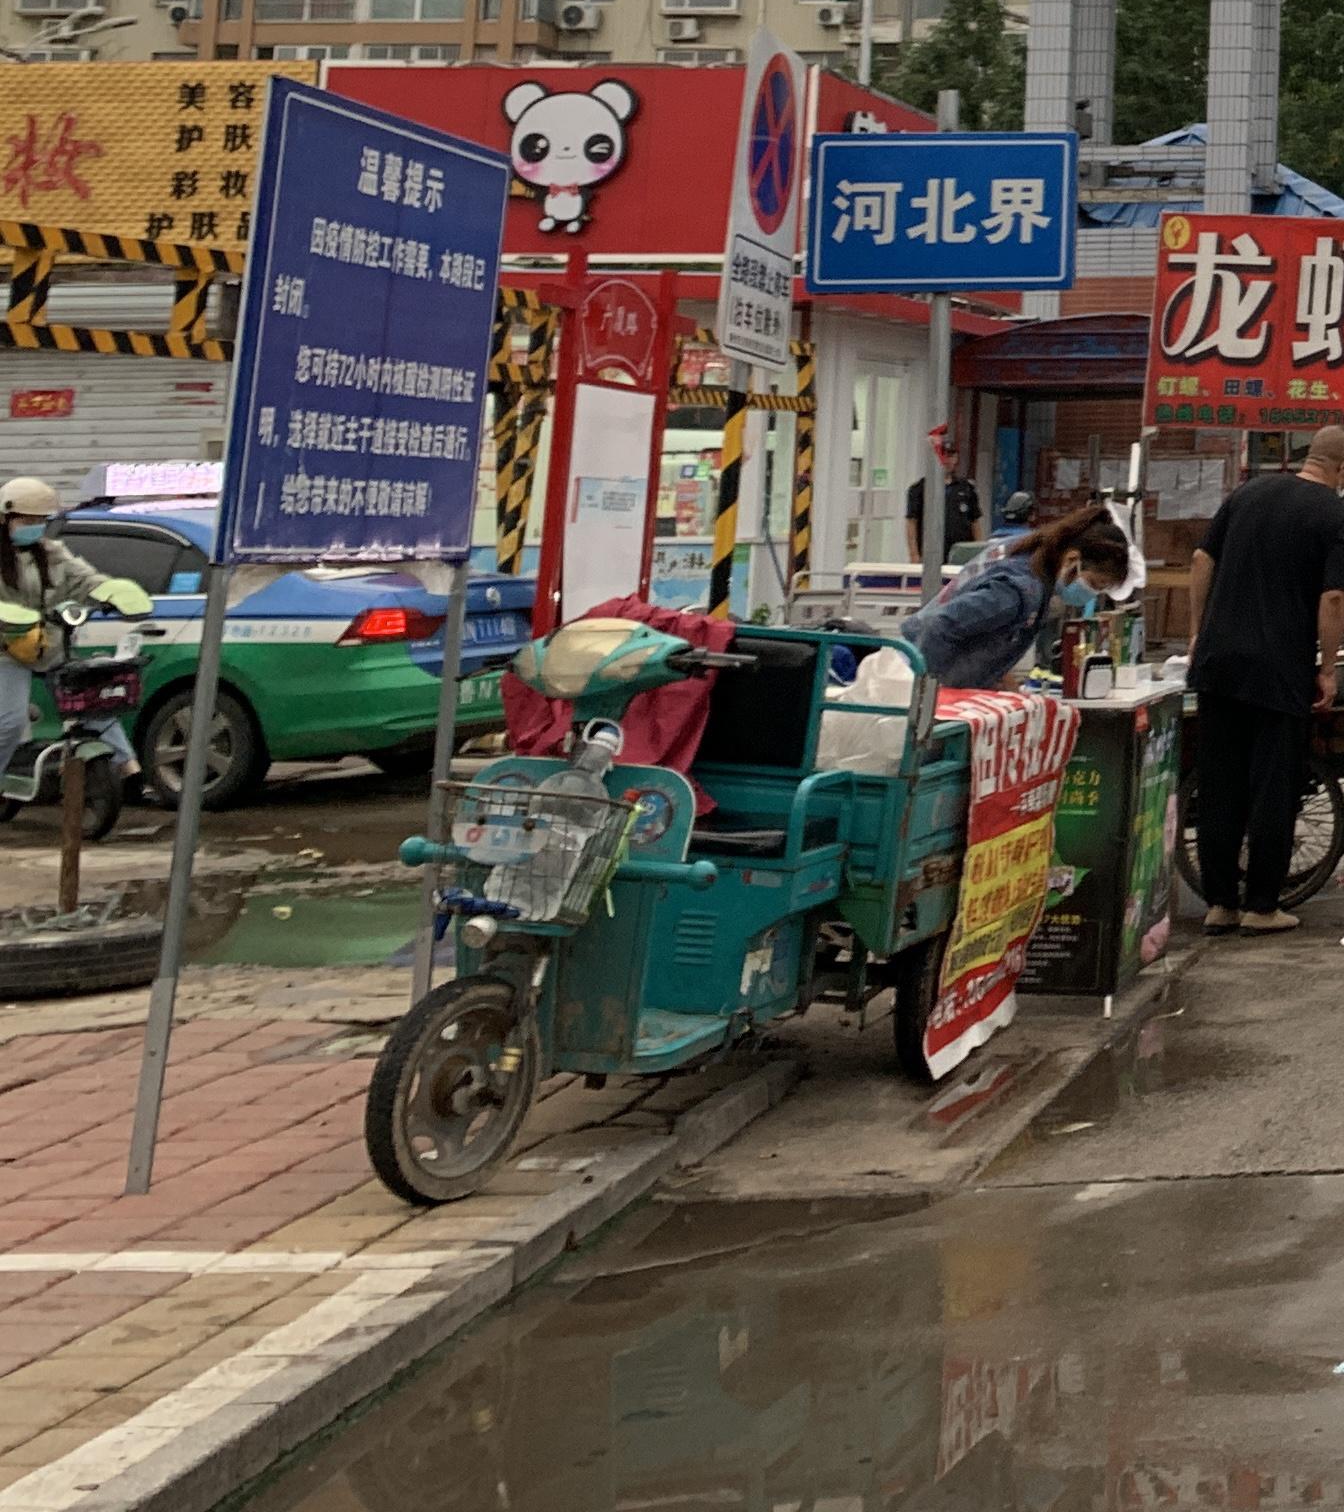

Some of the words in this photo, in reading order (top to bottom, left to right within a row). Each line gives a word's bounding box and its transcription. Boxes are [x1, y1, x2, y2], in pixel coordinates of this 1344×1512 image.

[178, 82, 256, 111] 美容
[175, 123, 252, 153] 护肤
[169, 169, 248, 200] 彩妆
[357, 145, 445, 213] 温馨提示
[831, 177, 1053, 246] 河北界
